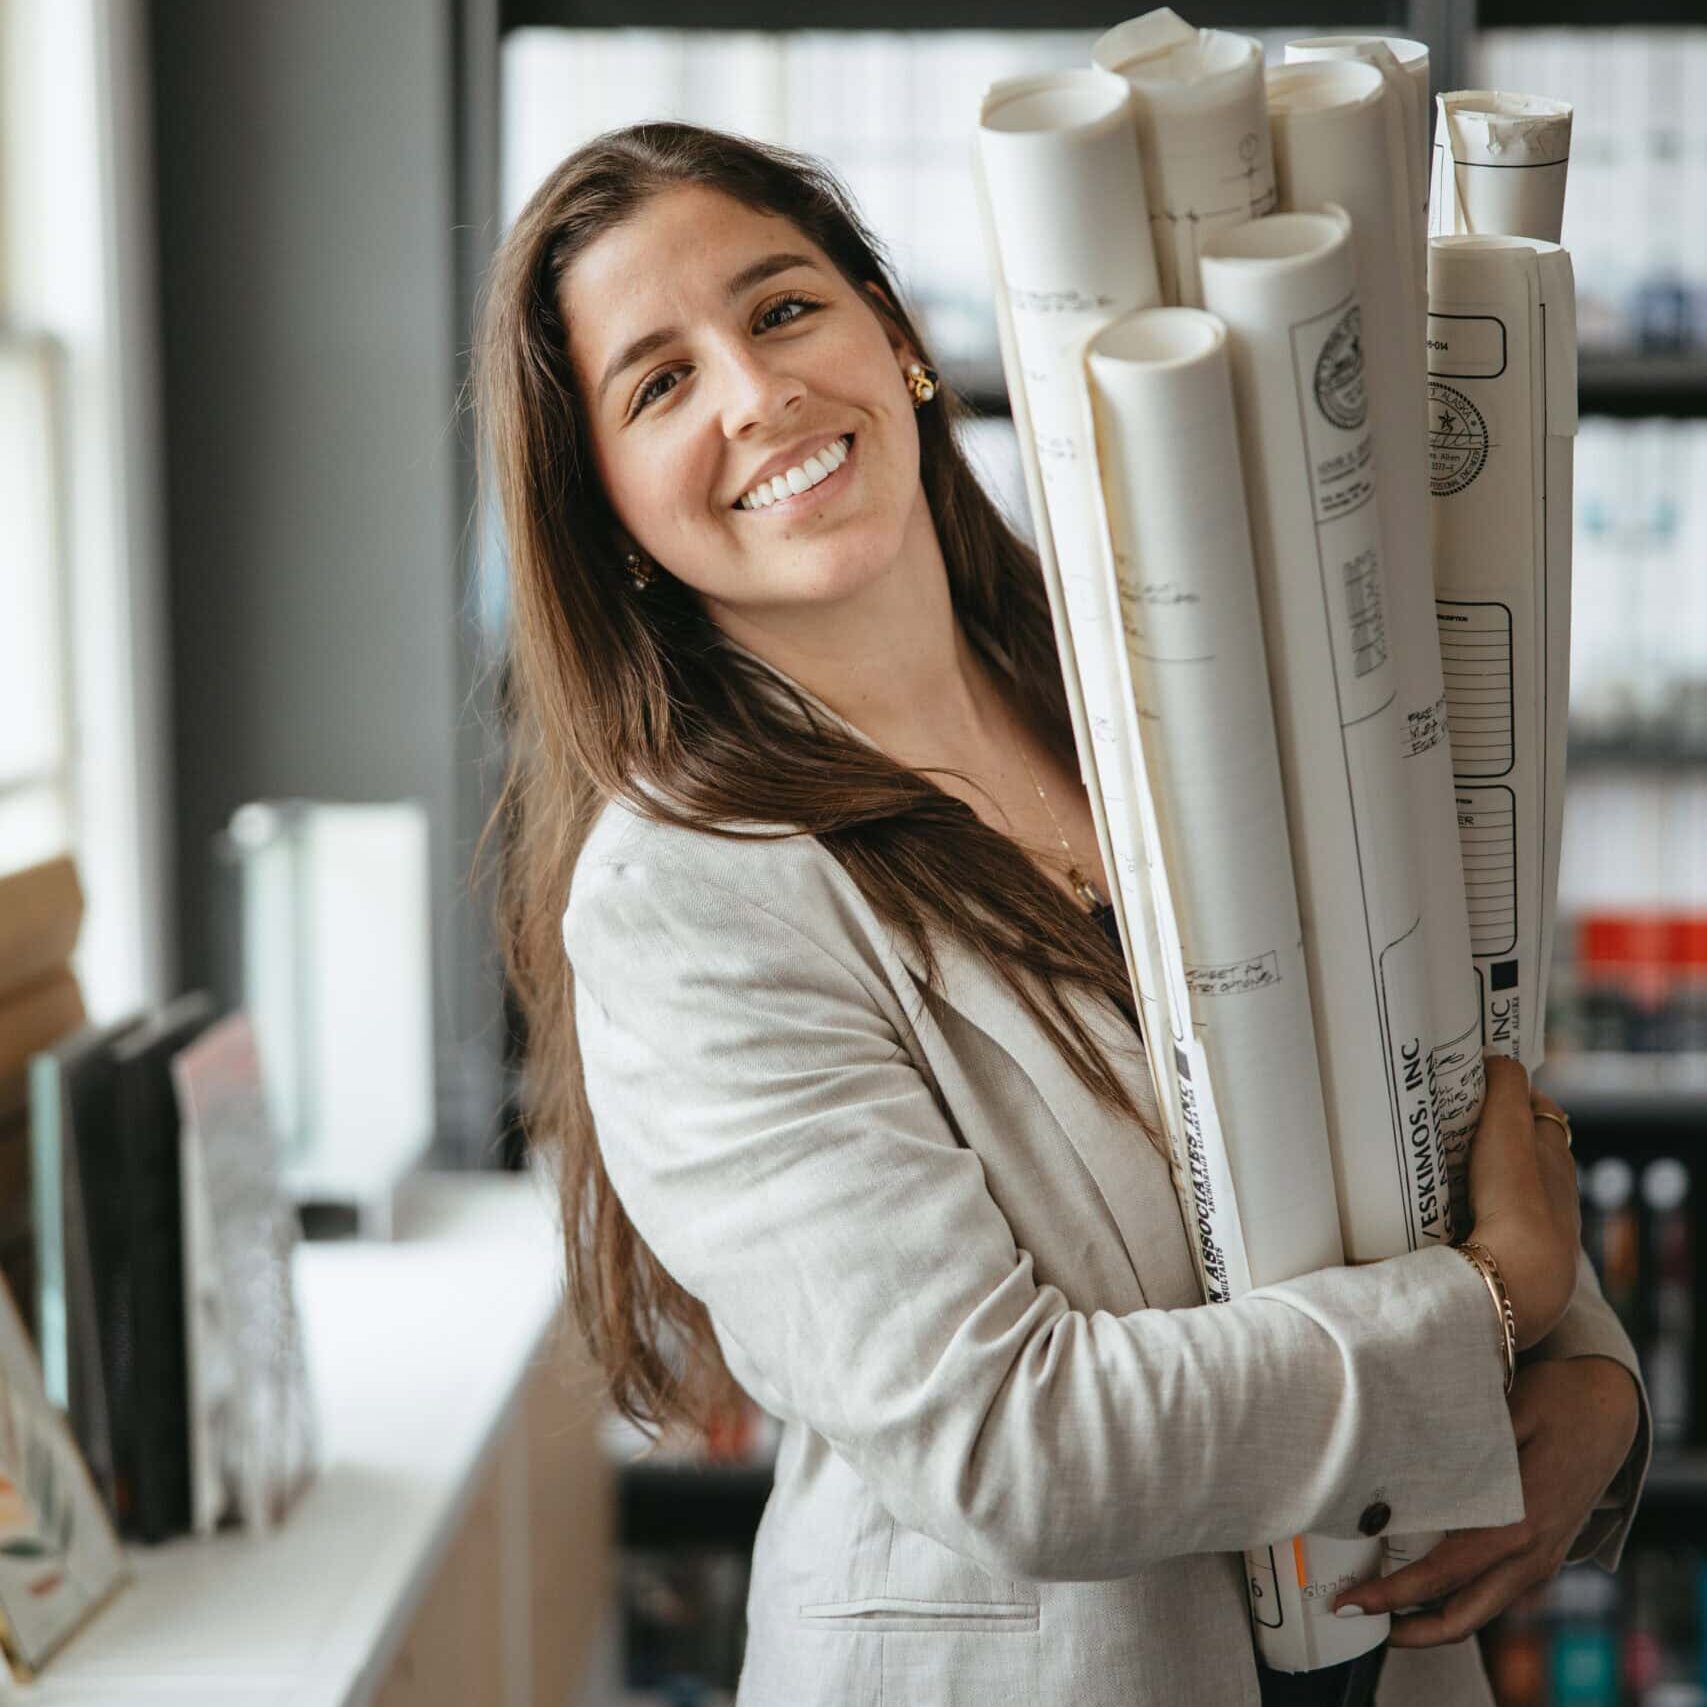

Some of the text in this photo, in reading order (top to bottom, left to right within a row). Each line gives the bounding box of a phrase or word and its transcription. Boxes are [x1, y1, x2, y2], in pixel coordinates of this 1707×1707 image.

[1441, 390, 1472, 419] ALASKA
[1491, 999, 1511, 1042] INC
[1511, 996, 1521, 1030] ALASKA
[1401, 1037, 1424, 1092] INC
[1179, 1081, 1197, 1126] INC
[1195, 1111, 1205, 1150] ALASKA
[1188, 1132, 1221, 1281] ASSOCIATES
[1200, 1157, 1216, 1214] ANCHORAGE
